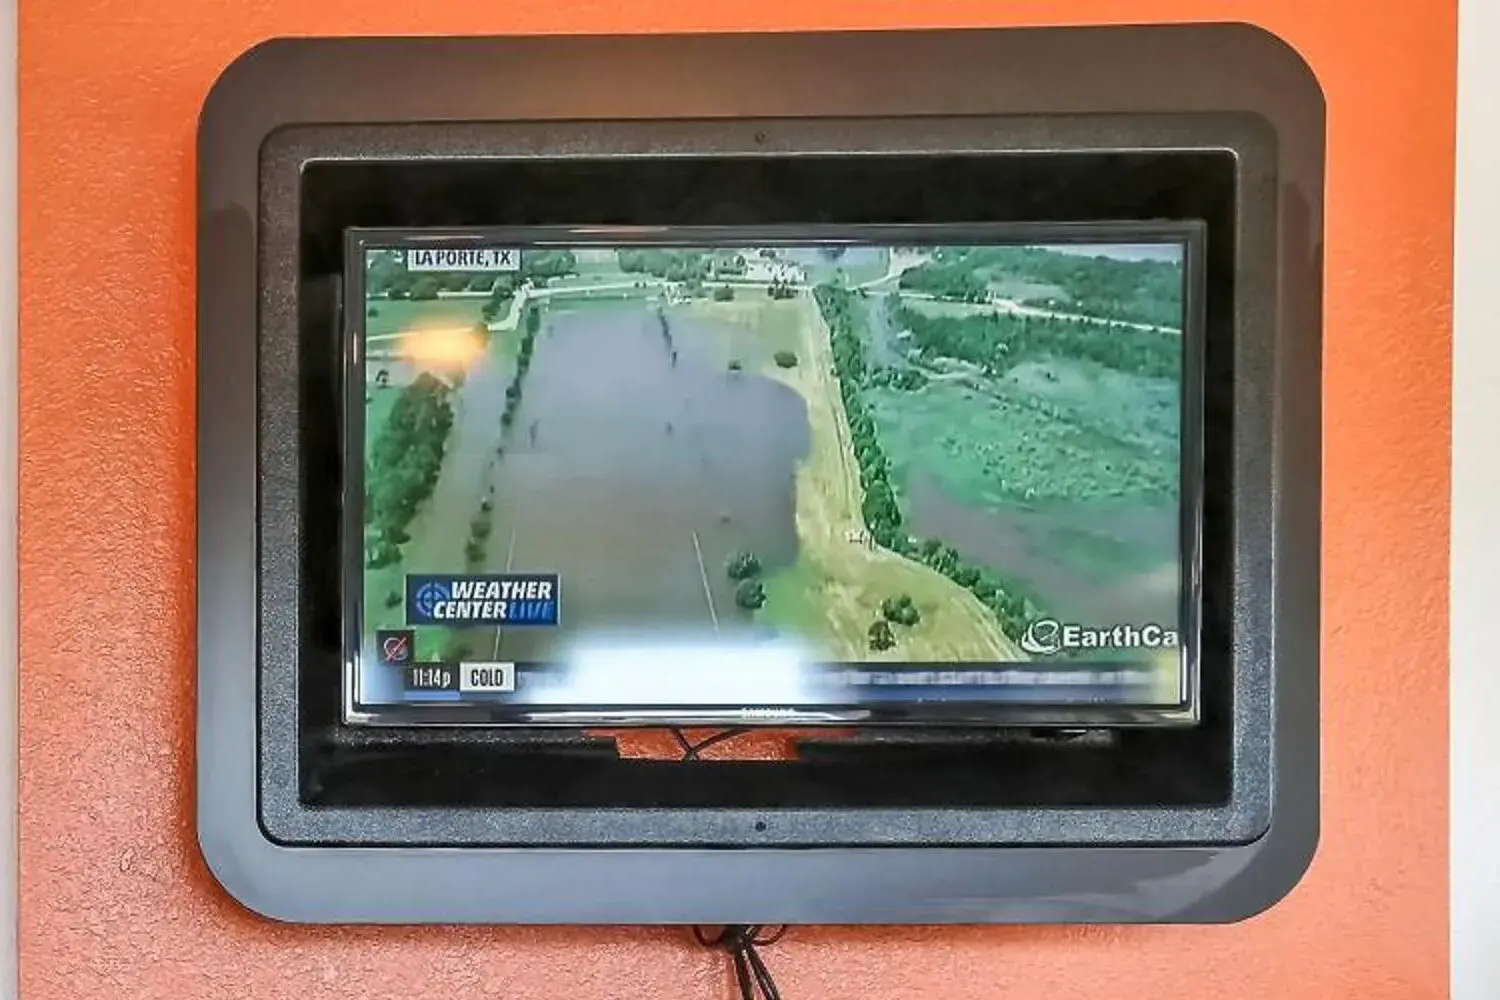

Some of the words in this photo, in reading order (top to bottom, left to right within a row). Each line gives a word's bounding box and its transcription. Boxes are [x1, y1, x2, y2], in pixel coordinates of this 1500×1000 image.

[435, 250, 490, 267] PORTE,
[494, 250, 511, 265] TX
[451, 581, 552, 600] WEATHER
[433, 601, 507, 619] CENTER
[470, 669, 502, 687] COLD
